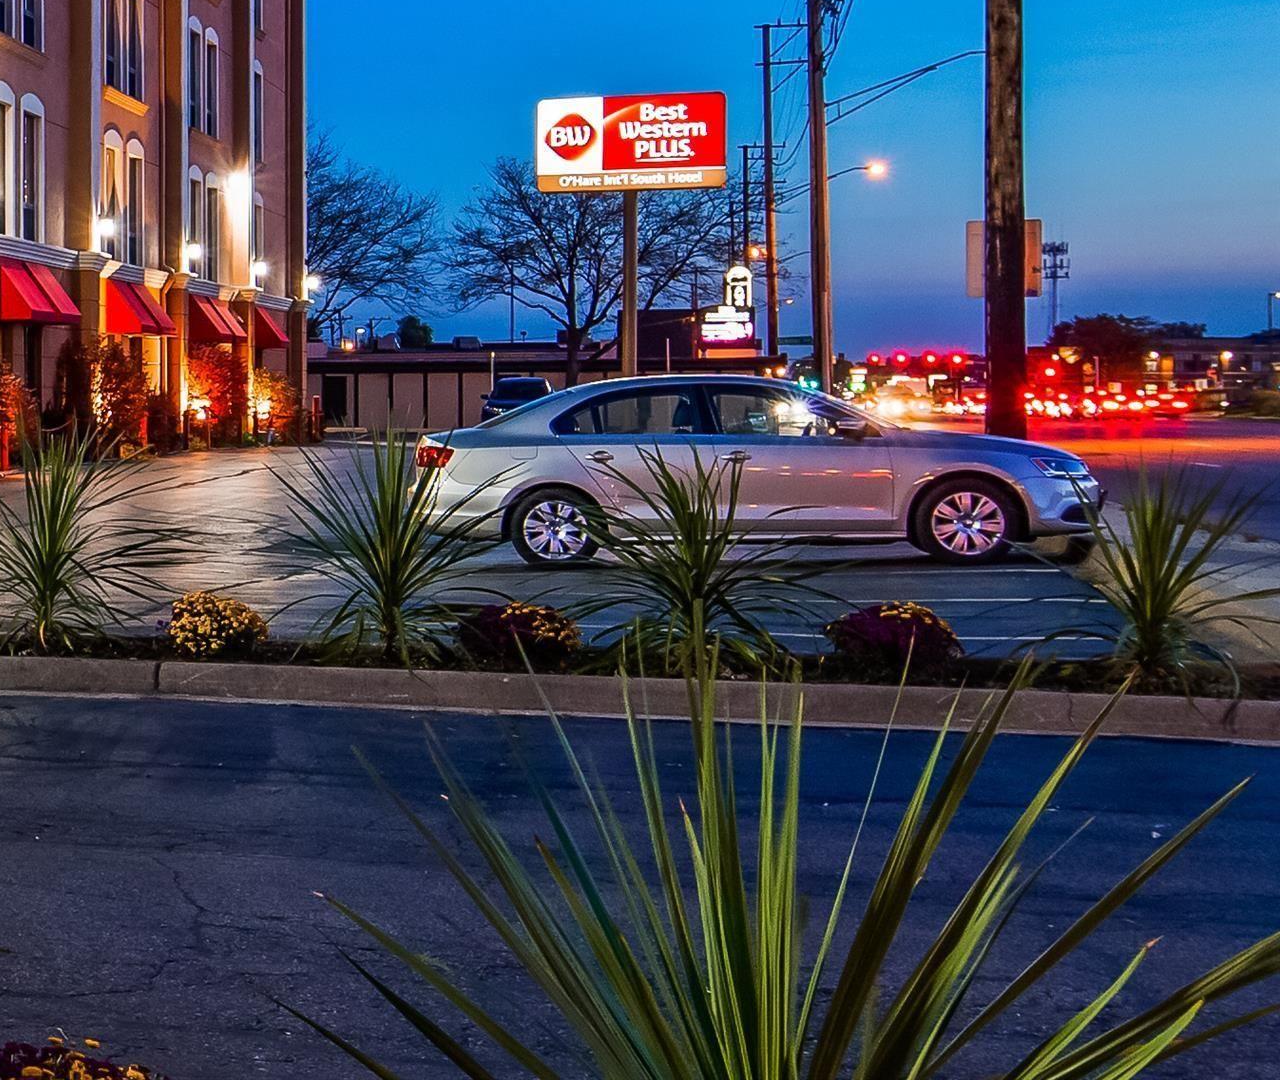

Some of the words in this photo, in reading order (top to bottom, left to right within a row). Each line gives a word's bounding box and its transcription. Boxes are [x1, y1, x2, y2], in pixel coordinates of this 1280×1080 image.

[640, 103, 688, 121] Best
[550, 125, 591, 147] BW
[619, 121, 707, 139] Western
[559, 175, 602, 187] O'Hare
[630, 172, 666, 184] South
[667, 170, 702, 183] Hotel
